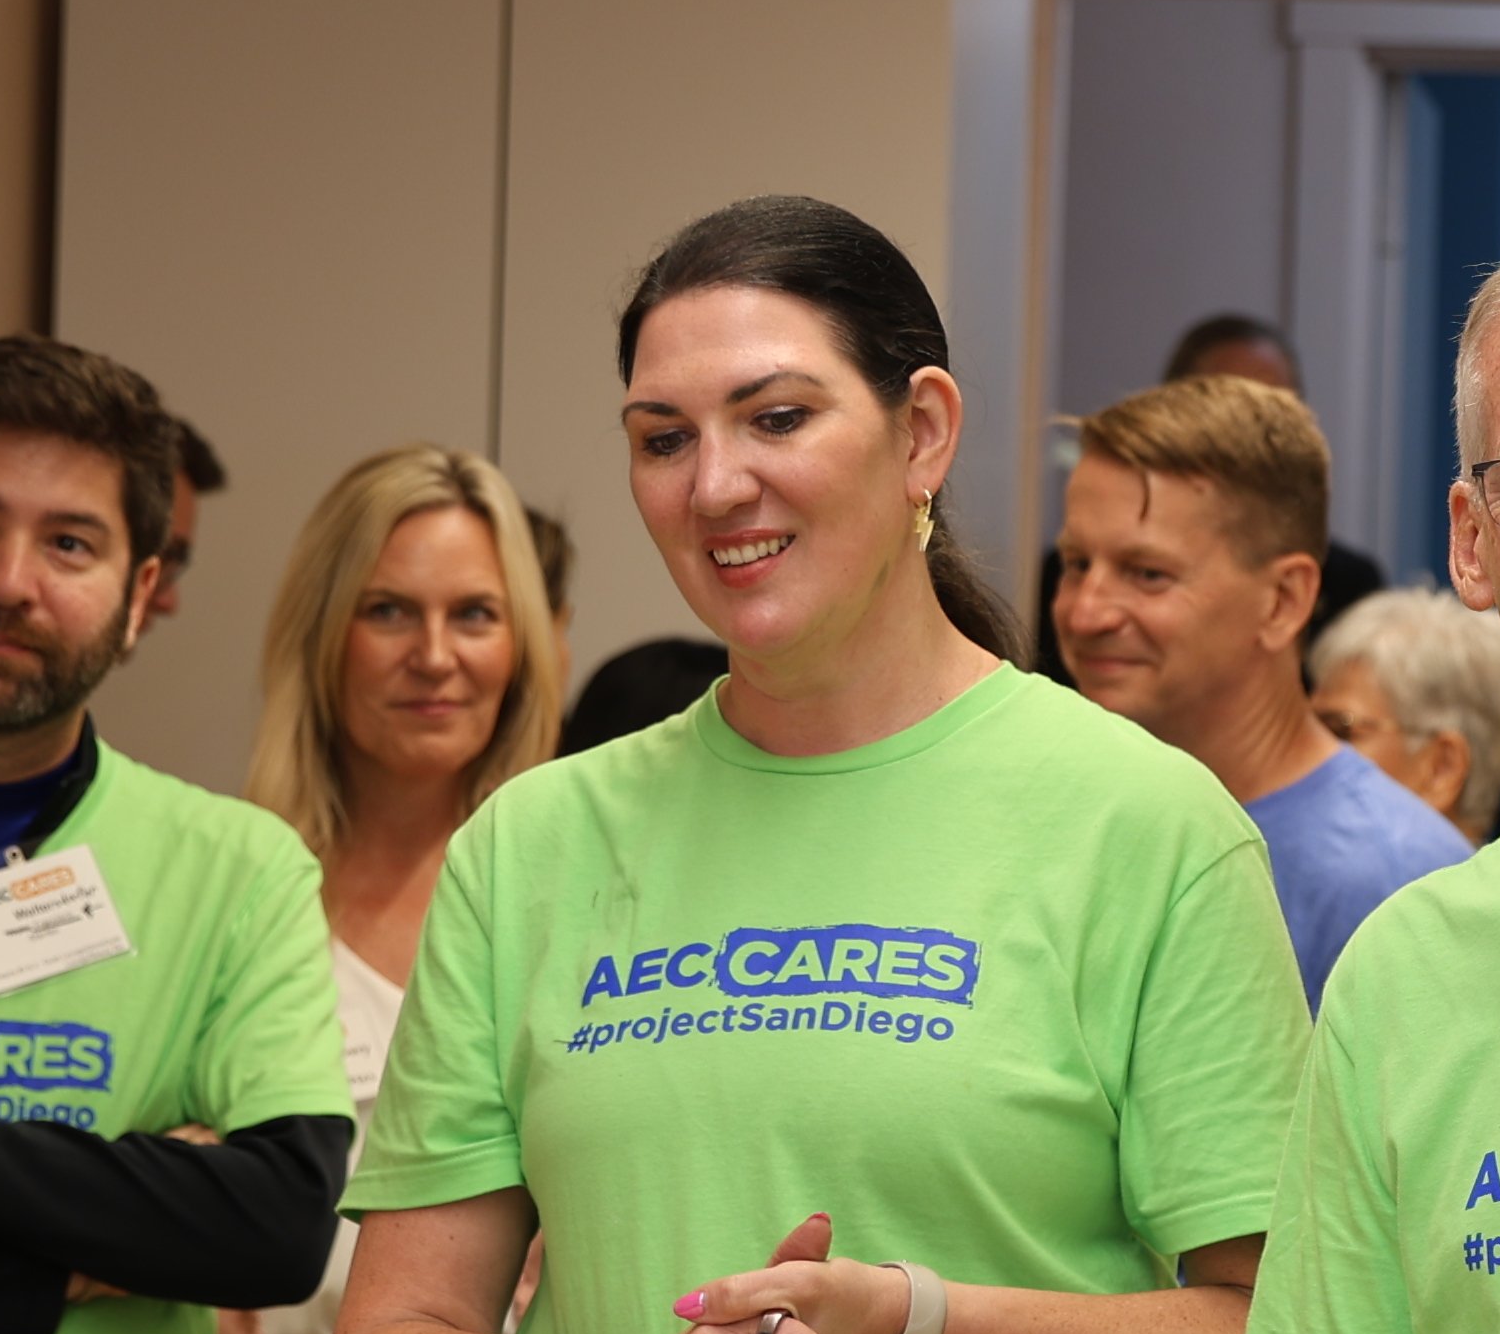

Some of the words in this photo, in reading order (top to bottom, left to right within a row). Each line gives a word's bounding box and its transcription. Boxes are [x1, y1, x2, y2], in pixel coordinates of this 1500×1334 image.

[582, 943, 713, 1007] AEC
[729, 939, 966, 991] CARES
[567, 1001, 955, 1054] #projectSanDiego
